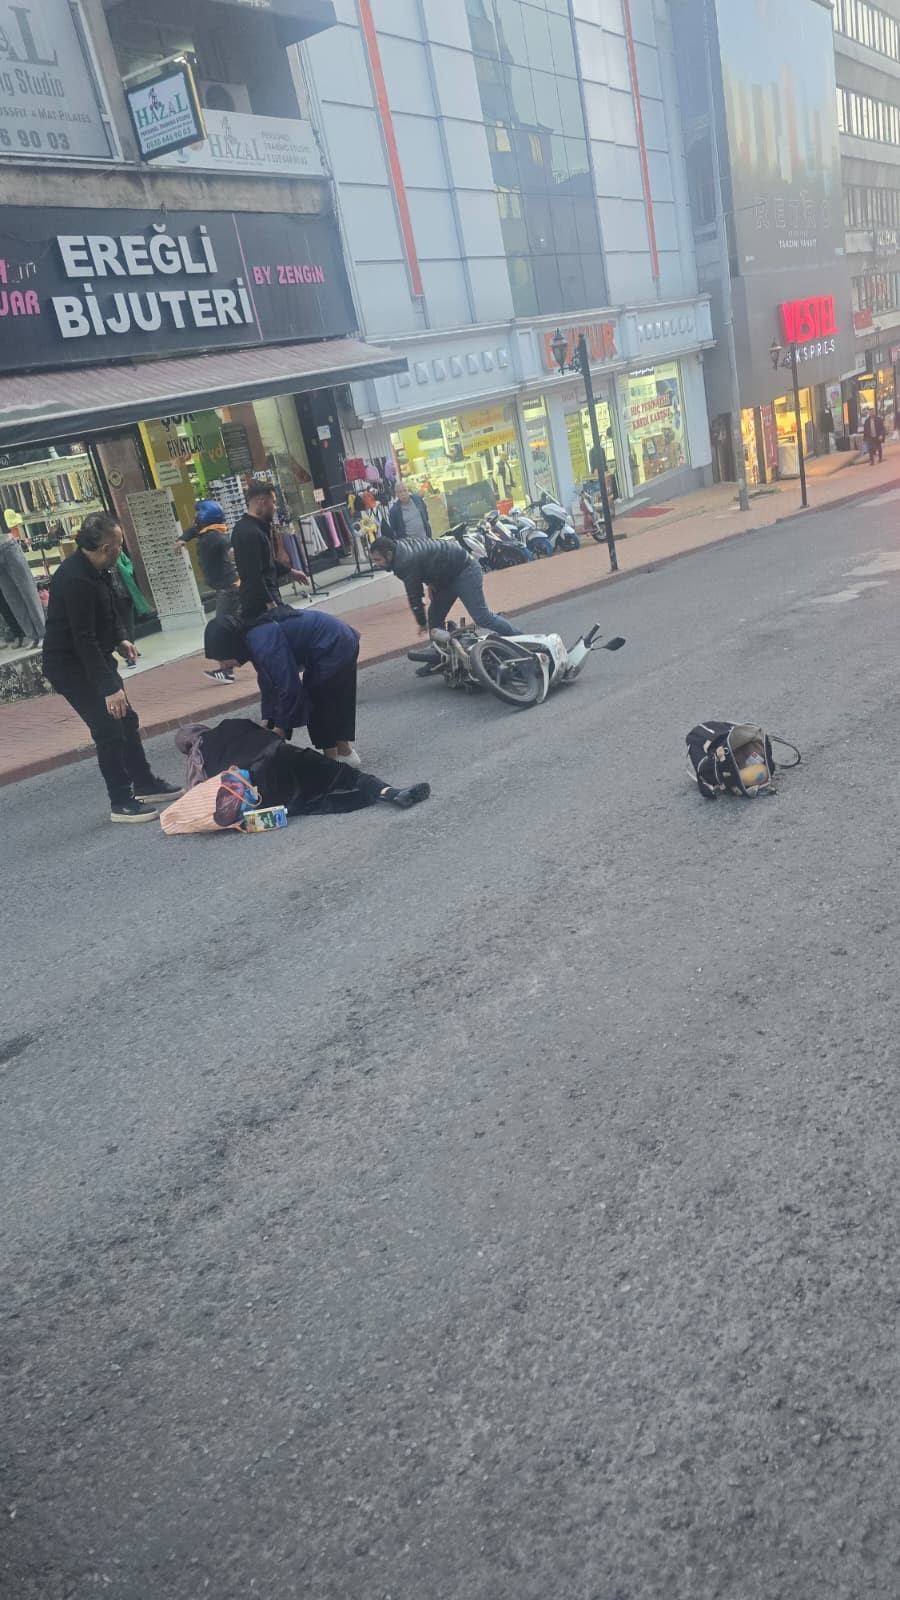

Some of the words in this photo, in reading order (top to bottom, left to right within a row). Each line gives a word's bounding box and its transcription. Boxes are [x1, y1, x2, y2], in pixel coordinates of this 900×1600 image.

[14, 68, 65, 98] Studio
[136, 93, 189, 129] HAZAL
[17, 129, 42, 149] 90
[46, 131, 70, 150] 03
[207, 133, 265, 161] HAZAL
[56, 223, 218, 278] EREĞLİ
[252, 265, 272, 285] BY
[52, 277, 254, 339] BİJUTERİ
[782, 294, 840, 341] VESTEL
